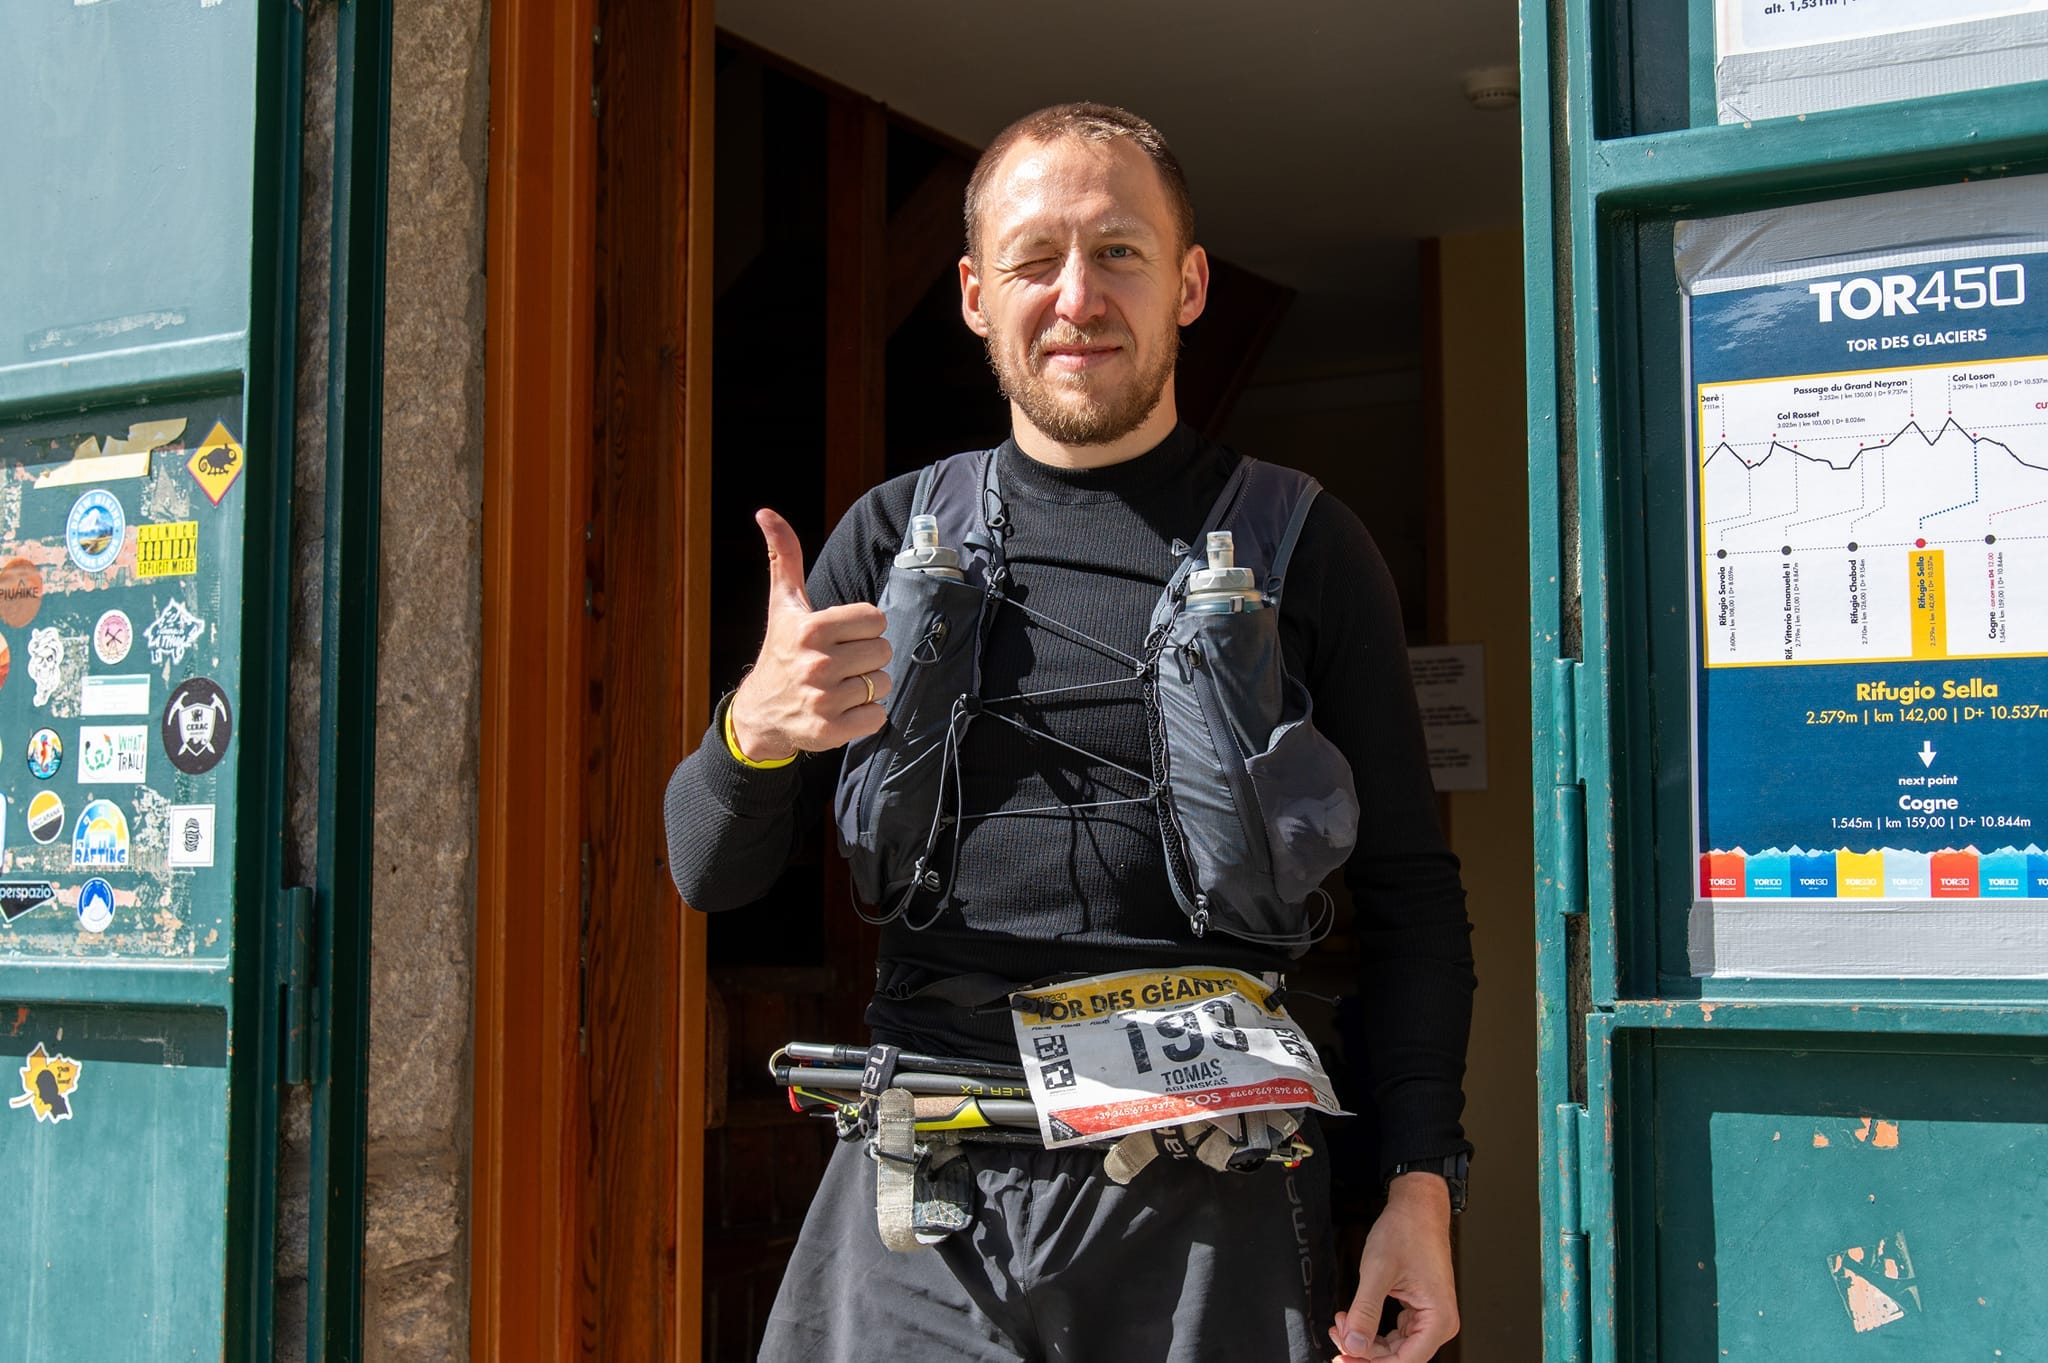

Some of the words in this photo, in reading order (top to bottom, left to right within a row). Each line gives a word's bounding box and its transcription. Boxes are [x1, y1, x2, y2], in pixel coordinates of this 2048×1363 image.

[1764, 3, 1785, 15] alt.
[1809, 263, 2025, 323] TOR450
[1847, 338, 1879, 353] TOR
[1881, 335, 1910, 350] DES
[1913, 328, 1988, 348] GLACIERS
[1793, 386, 1829, 395] Passage
[1831, 384, 1842, 392] du
[1844, 381, 1872, 390] Grand
[1874, 379, 1908, 389] Neyron
[1952, 373, 1967, 382] Col
[1969, 373, 1995, 381] Loson
[1777, 412, 1791, 420] Col
[1792, 411, 1820, 419] Rosset
[1848, 559, 1857, 592] Chabod
[1916, 556, 1925, 577] Sella
[1717, 566, 1727, 595] Savoia
[1783, 571, 1792, 611] Emanuele
[1917, 579, 1927, 609] Rifugio
[1718, 597, 1729, 626] Rifugio
[1794, 615, 1800, 623] km
[1850, 594, 1860, 624] Rifugio
[1861, 612, 1867, 620] km
[1999, 610, 2005, 618] km
[1729, 618, 1736, 627] km
[1784, 613, 1792, 645] Vittorio
[1988, 611, 1998, 639] Cogne
[1785, 646, 1793, 660] Rif.
[1856, 680, 1936, 706] Rifugio
[1943, 678, 1999, 699] Sella
[1806, 710, 1858, 724] 2.579m
[1874, 709, 1894, 723] km
[1899, 707, 1948, 723] 142,00
[1964, 707, 1985, 720] D+
[1990, 704, 2048, 720] 10.537m
[118, 733, 143, 752] WHAT
[117, 752, 144, 775] TRAIL!
[1898, 775, 1926, 786] next
[1927, 774, 1958, 788] point
[1898, 794, 1959, 814] Cogne
[1831, 817, 1873, 829] 1.545m
[1885, 817, 1902, 829] km
[1905, 816, 1946, 830] 159,00
[1959, 816, 1976, 828] D+
[1980, 815, 2031, 828] 10.844m
[74, 848, 126, 863] RAFTING
[1089, 988, 1136, 1014] DES
[1161, 1058, 1223, 1086] TOMAS
[1184, 1092, 1222, 1108] SOS
